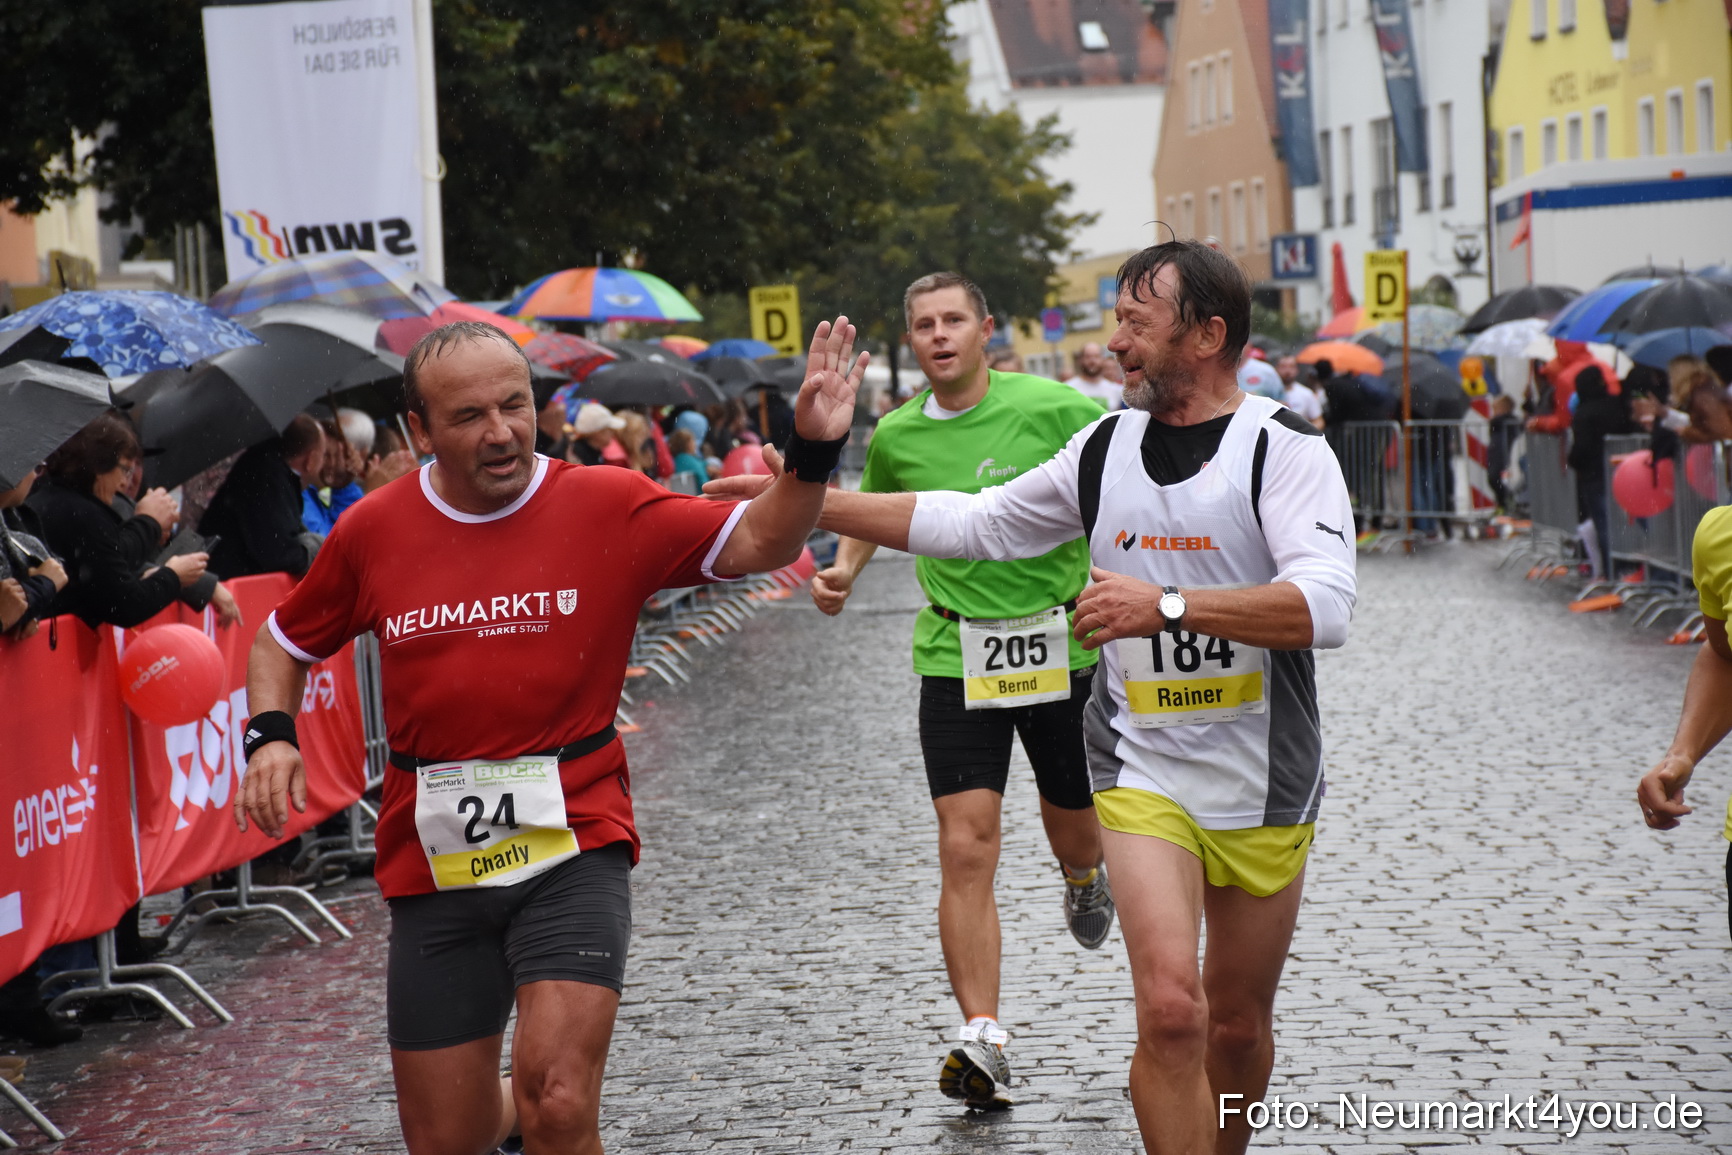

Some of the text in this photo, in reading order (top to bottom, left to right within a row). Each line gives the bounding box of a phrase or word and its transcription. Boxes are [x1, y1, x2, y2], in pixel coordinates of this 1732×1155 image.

[1376, 272, 1398, 306] D
[764, 308, 788, 341] D
[1141, 535, 1220, 550] KLEBL
[386, 592, 550, 640] NEUMARKT
[1006, 611, 1057, 629] BOCK
[477, 624, 549, 638] STARKE STADT
[984, 633, 1048, 671] 205
[1142, 630, 1235, 673] 184
[998, 676, 1037, 694] Bernd
[1157, 686, 1223, 707] Rainer
[426, 778, 466, 790] NeuerMarkt
[473, 762, 547, 782] BOCK
[457, 792, 520, 844] 24
[470, 844, 529, 878] Charly
